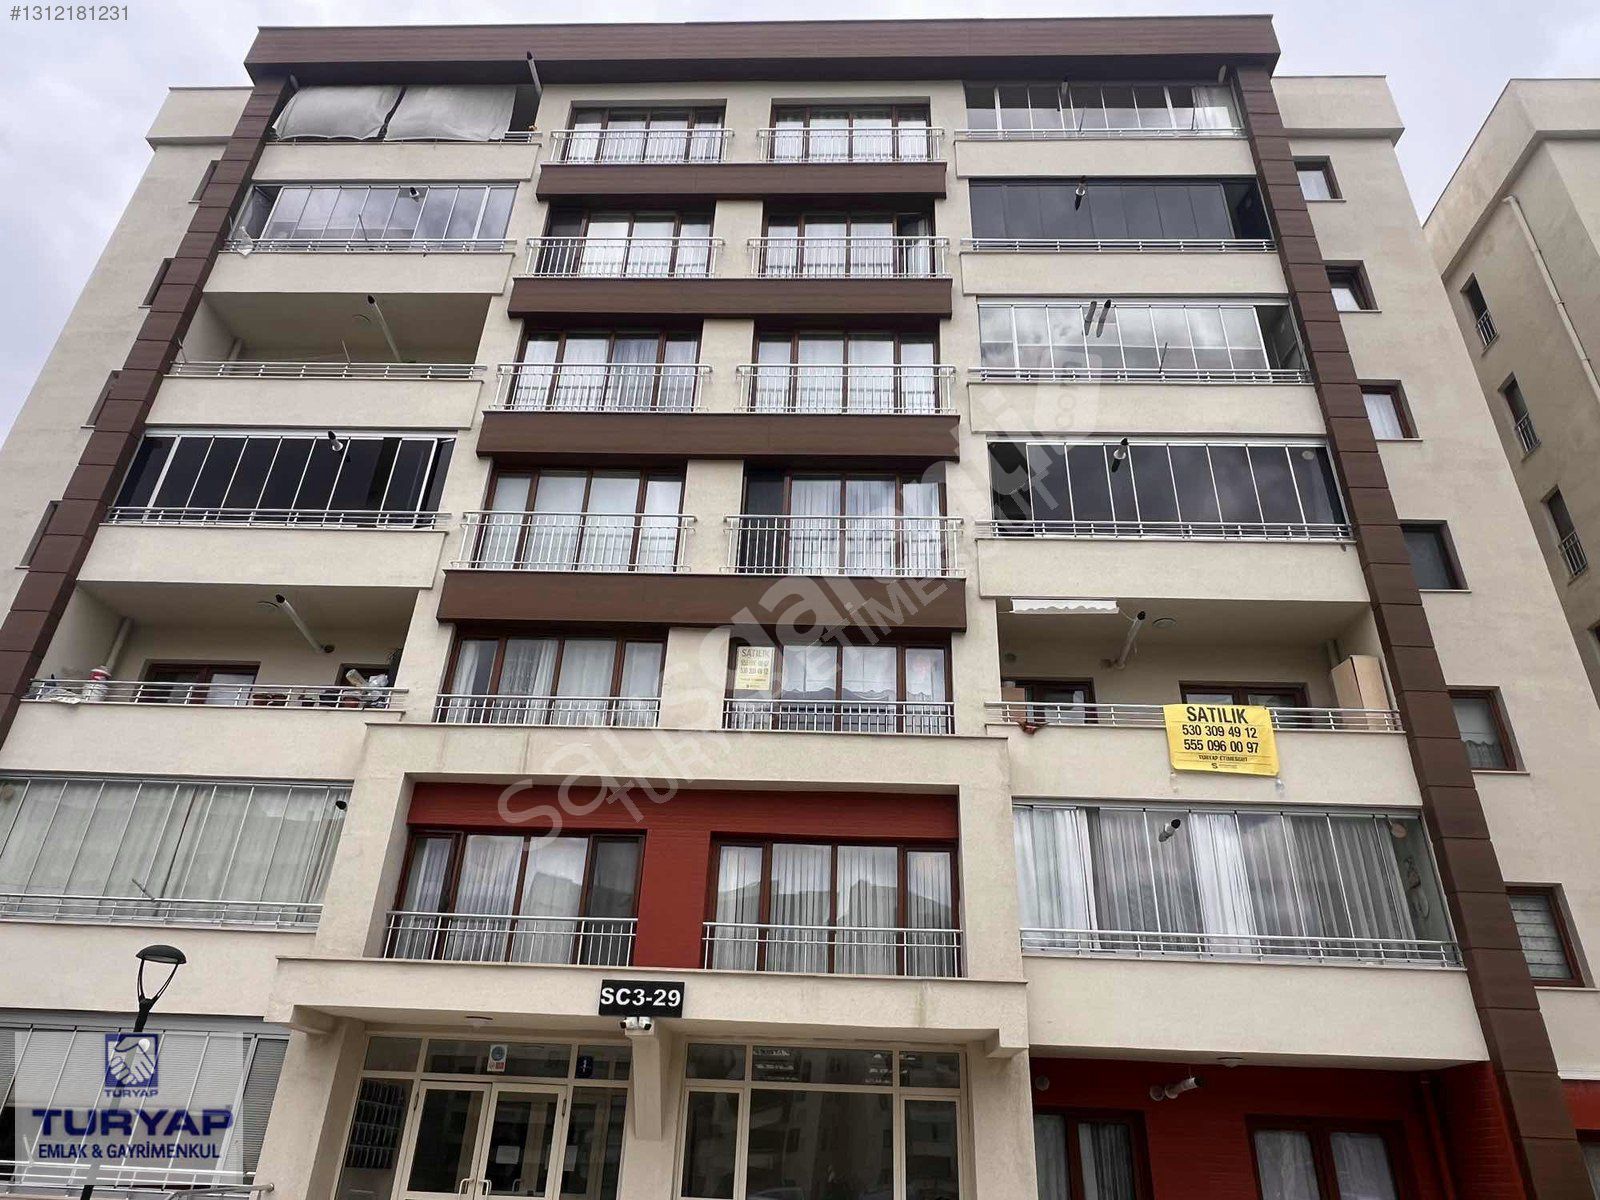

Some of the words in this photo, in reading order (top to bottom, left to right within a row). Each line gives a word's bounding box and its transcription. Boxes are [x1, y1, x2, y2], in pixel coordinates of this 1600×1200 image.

[1186, 706, 1248, 724] SATILIK
[1182, 725, 1202, 736] 530
[1205, 725, 1225, 737] 309
[1228, 726, 1241, 738] 49
[1244, 727, 1258, 739] 12
[1184, 739, 1204, 751] 555
[1207, 740, 1227, 752] 096
[1230, 741, 1243, 753] 00
[1246, 742, 1259, 754] 97
[600, 987, 681, 1007] SC3-29
